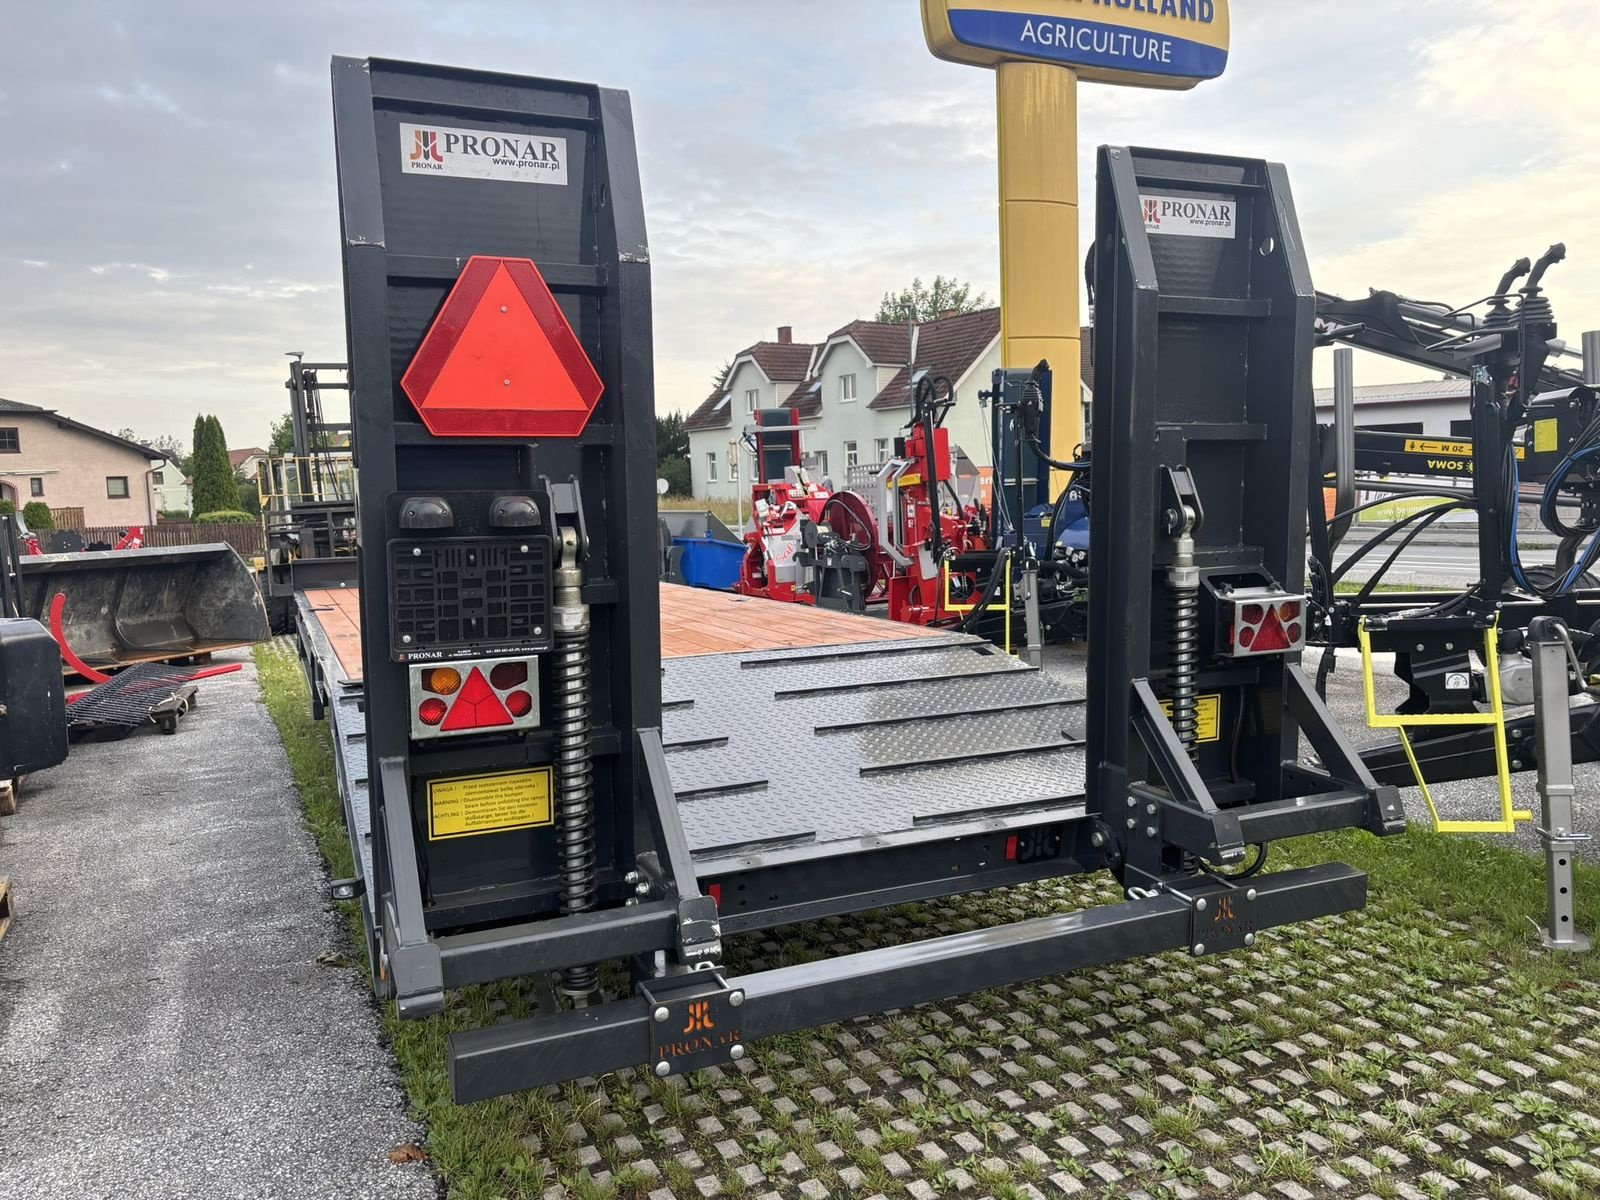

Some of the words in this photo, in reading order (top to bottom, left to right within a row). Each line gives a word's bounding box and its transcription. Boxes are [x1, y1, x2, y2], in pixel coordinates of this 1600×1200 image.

[1020, 19, 1172, 63] AGRICULTURE
[443, 133, 559, 162] PRONAR
[411, 161, 443, 170] PRONAR
[492, 157, 560, 171] www.pronar.pl
[1161, 200, 1230, 221] PRONAR
[1189, 218, 1232, 227] www.pronar.pl
[1441, 444, 1450, 452] M
[1452, 445, 1464, 453] 20
[1427, 459, 1464, 470] SOMA
[407, 651, 443, 660] PRONAR
[434, 798, 459, 806] WARNING
[434, 811, 460, 819] ACHTUNG
[660, 1029, 741, 1058] PRONAR
